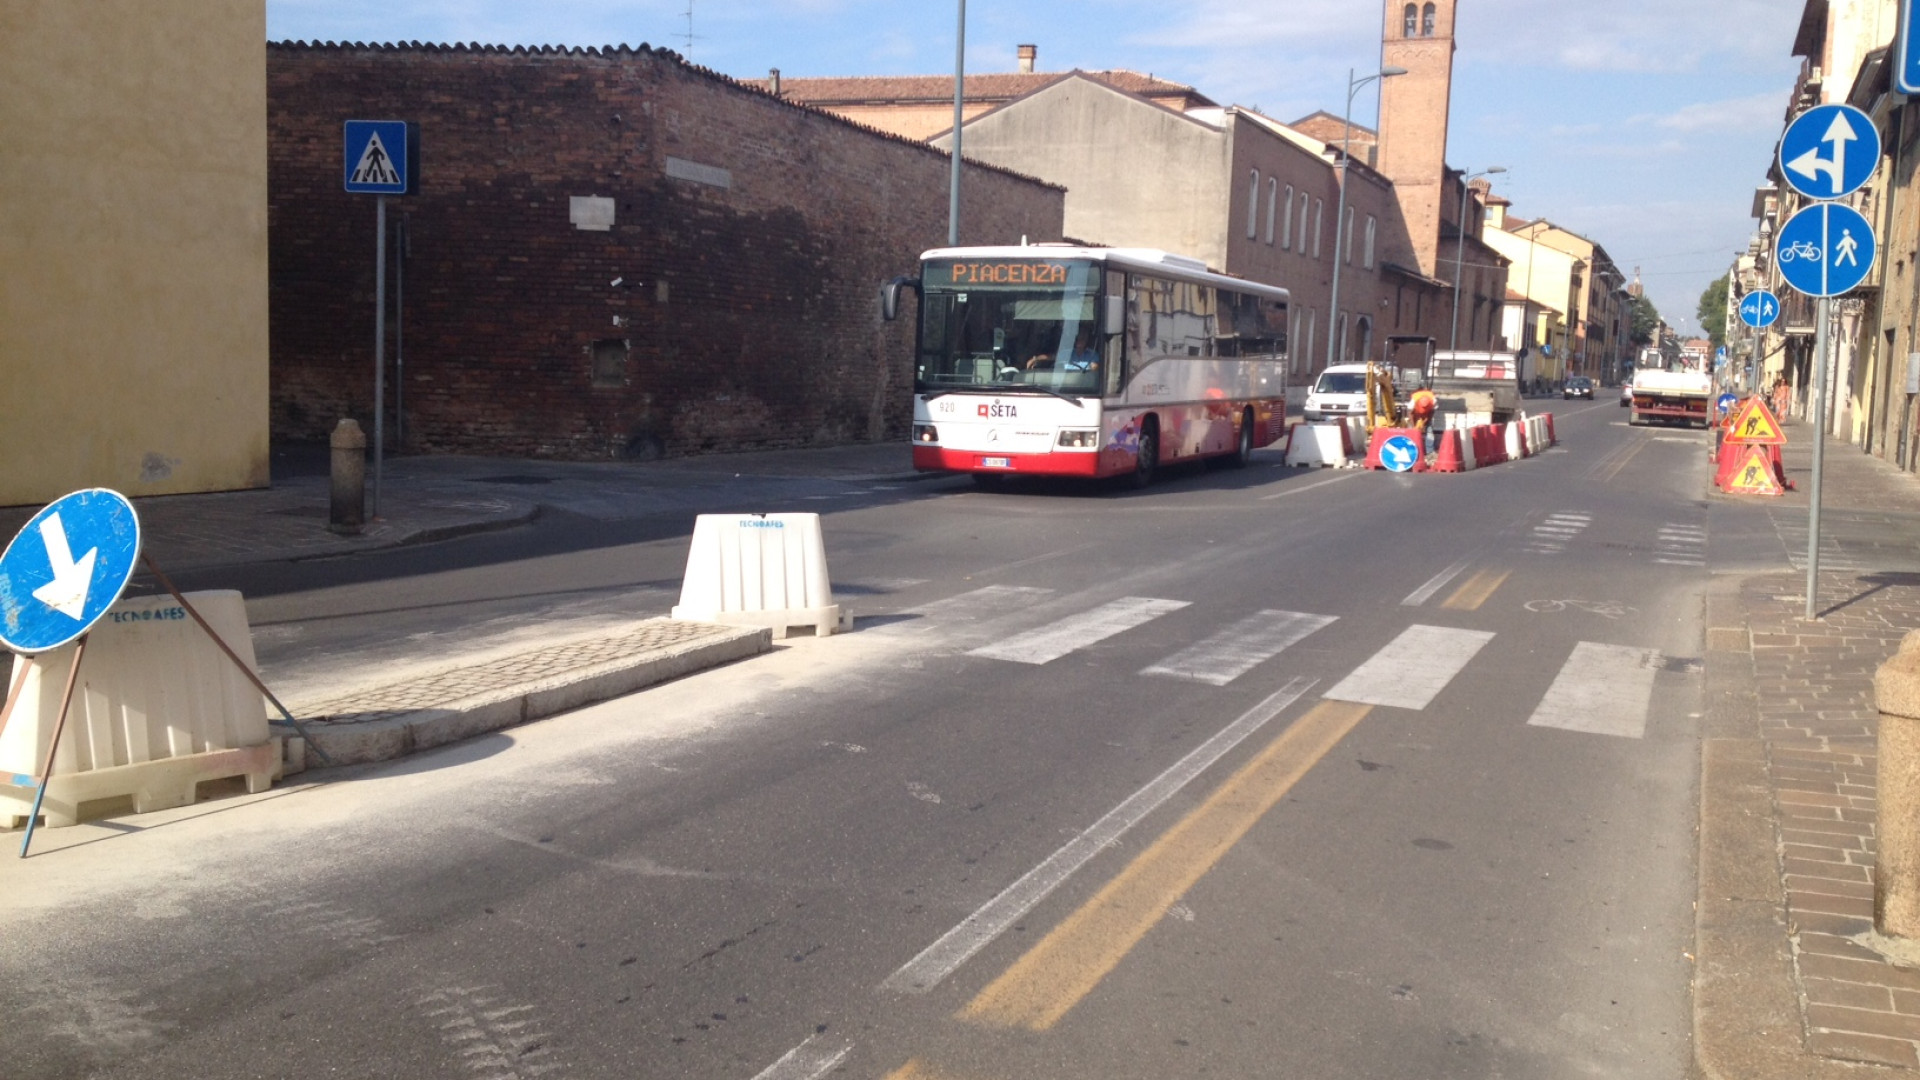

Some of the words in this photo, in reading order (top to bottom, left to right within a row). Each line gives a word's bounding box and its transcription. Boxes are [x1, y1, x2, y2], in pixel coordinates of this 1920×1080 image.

[952, 263, 1067, 283] PIACENZA
[939, 402, 955, 413] 920
[991, 405, 1018, 418] SETA
